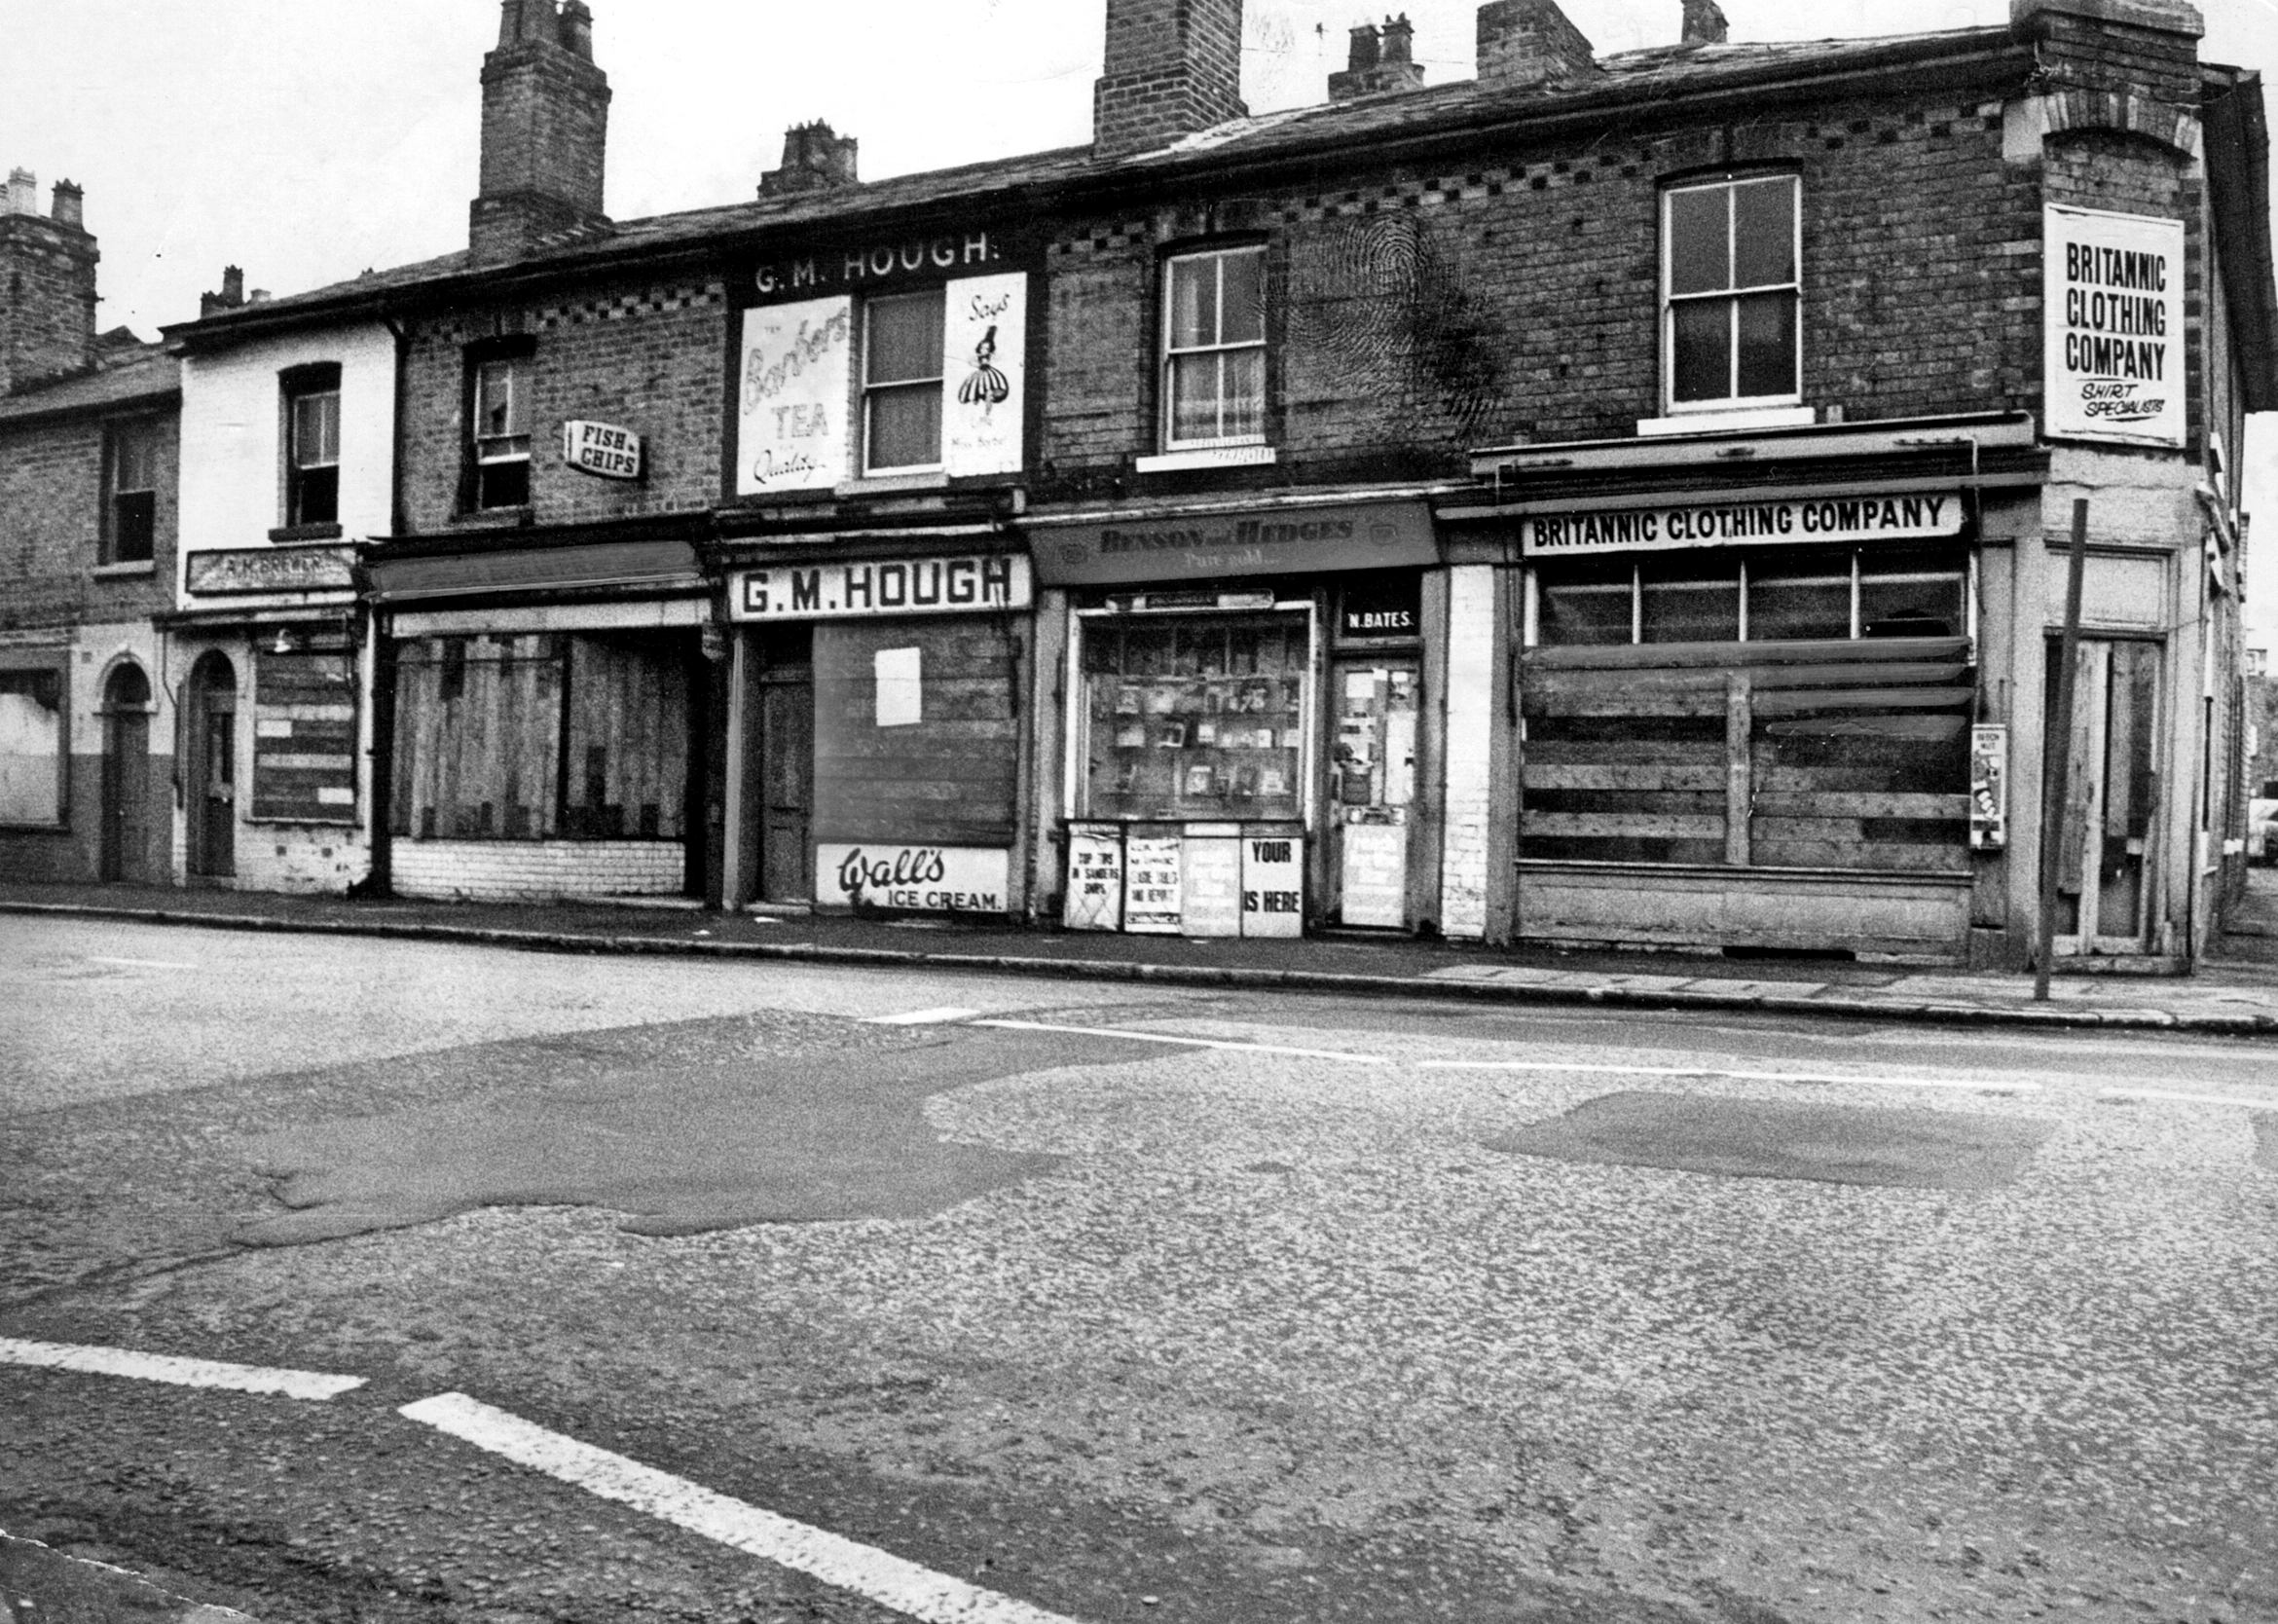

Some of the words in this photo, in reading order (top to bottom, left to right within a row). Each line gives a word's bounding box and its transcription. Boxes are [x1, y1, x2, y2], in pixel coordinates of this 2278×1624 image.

[2066, 241, 2167, 292] BRITANNIC
[2066, 287, 2167, 337] CLOTHING
[2065, 332, 2167, 381] COMPANY
[2080, 383, 2140, 400] SHIRT
[770, 402, 829, 440] TEA
[2083, 399, 2166, 418] SPECIALISTS
[582, 424, 626, 450] FISH
[581, 448, 636, 473] CHIPS
[1533, 512, 1657, 547] BRITANNIC
[1667, 505, 1793, 539] CLOTHING
[1802, 496, 1946, 533] COMPANY
[1252, 841, 1292, 864] YOUR
[837, 847, 944, 892] Wall's
[889, 890, 919, 906] ICE
[1243, 890, 1259, 913] IS
[1264, 891, 1301, 913] HERE
